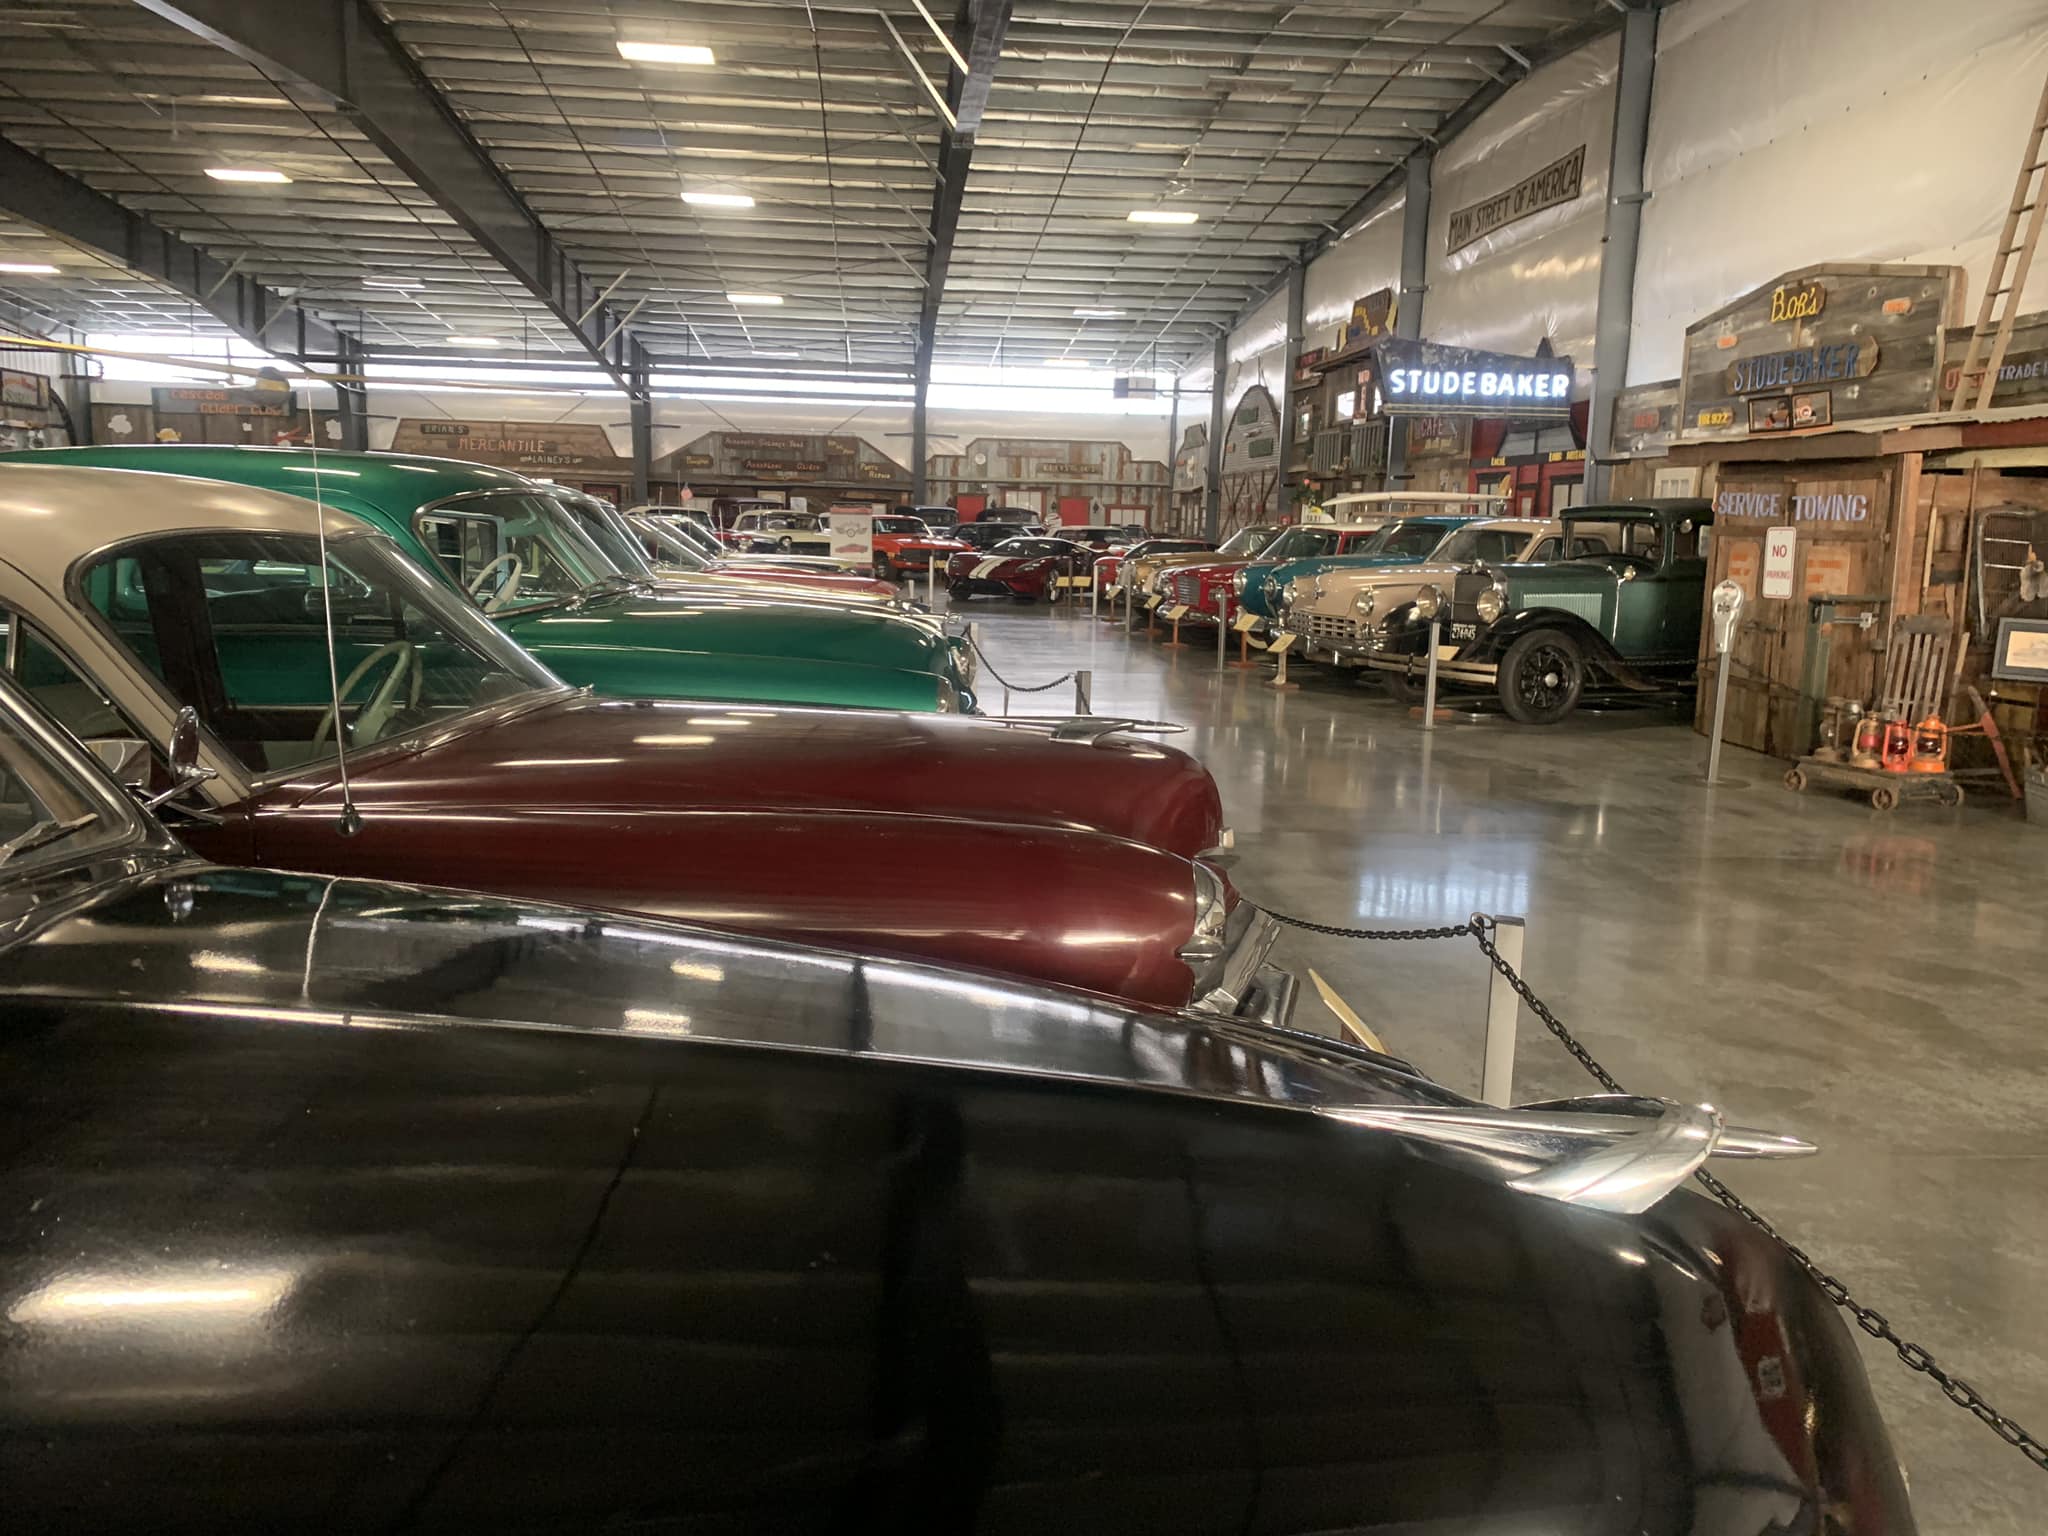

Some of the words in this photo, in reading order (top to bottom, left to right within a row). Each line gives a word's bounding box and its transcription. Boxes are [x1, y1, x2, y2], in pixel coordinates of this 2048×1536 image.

[1450, 213, 1473, 246] MAIN
[1475, 195, 1511, 233] STREET
[1513, 186, 1528, 214] OF
[1527, 155, 1579, 209] AMERICA
[1734, 344, 1861, 392] STUDEBAKER
[1999, 361, 2041, 381] TRADE
[1390, 369, 1570, 398] STUDEBAKER
[459, 438, 545, 453] MERCANTILE
[1718, 491, 1782, 518] SERVICE
[1792, 494, 1867, 521] TOWING
[1772, 545, 1787, 558] NO
